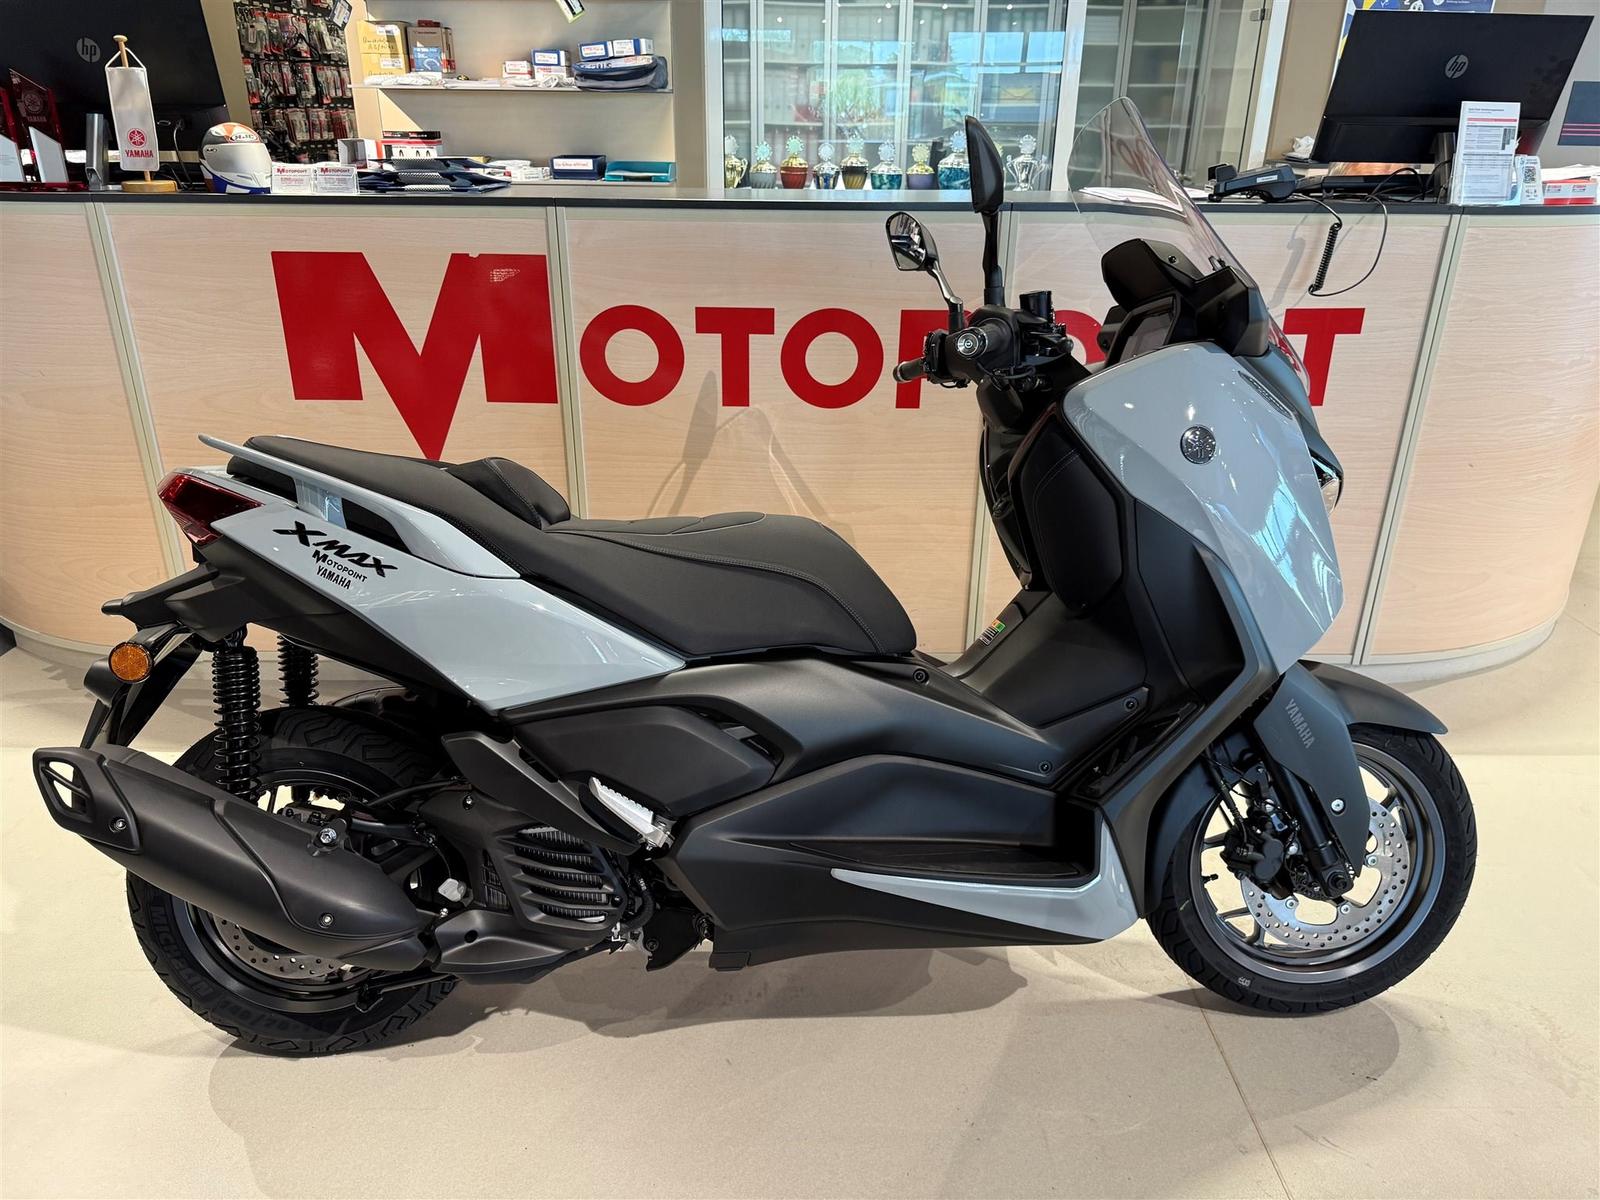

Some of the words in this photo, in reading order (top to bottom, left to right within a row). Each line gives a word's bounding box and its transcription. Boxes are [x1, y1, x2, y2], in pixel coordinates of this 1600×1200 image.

[80, 37, 98, 62] hp
[1446, 55, 1468, 79] hp
[125, 149, 154, 158] YAMAHA
[276, 167, 308, 175] MOTOPOINT
[312, 549, 368, 583] MOTOPOINT
[316, 565, 352, 590] YAMAHA
[1285, 698, 1316, 749] YAMAHA
[150, 903, 215, 999] MICHELIN
